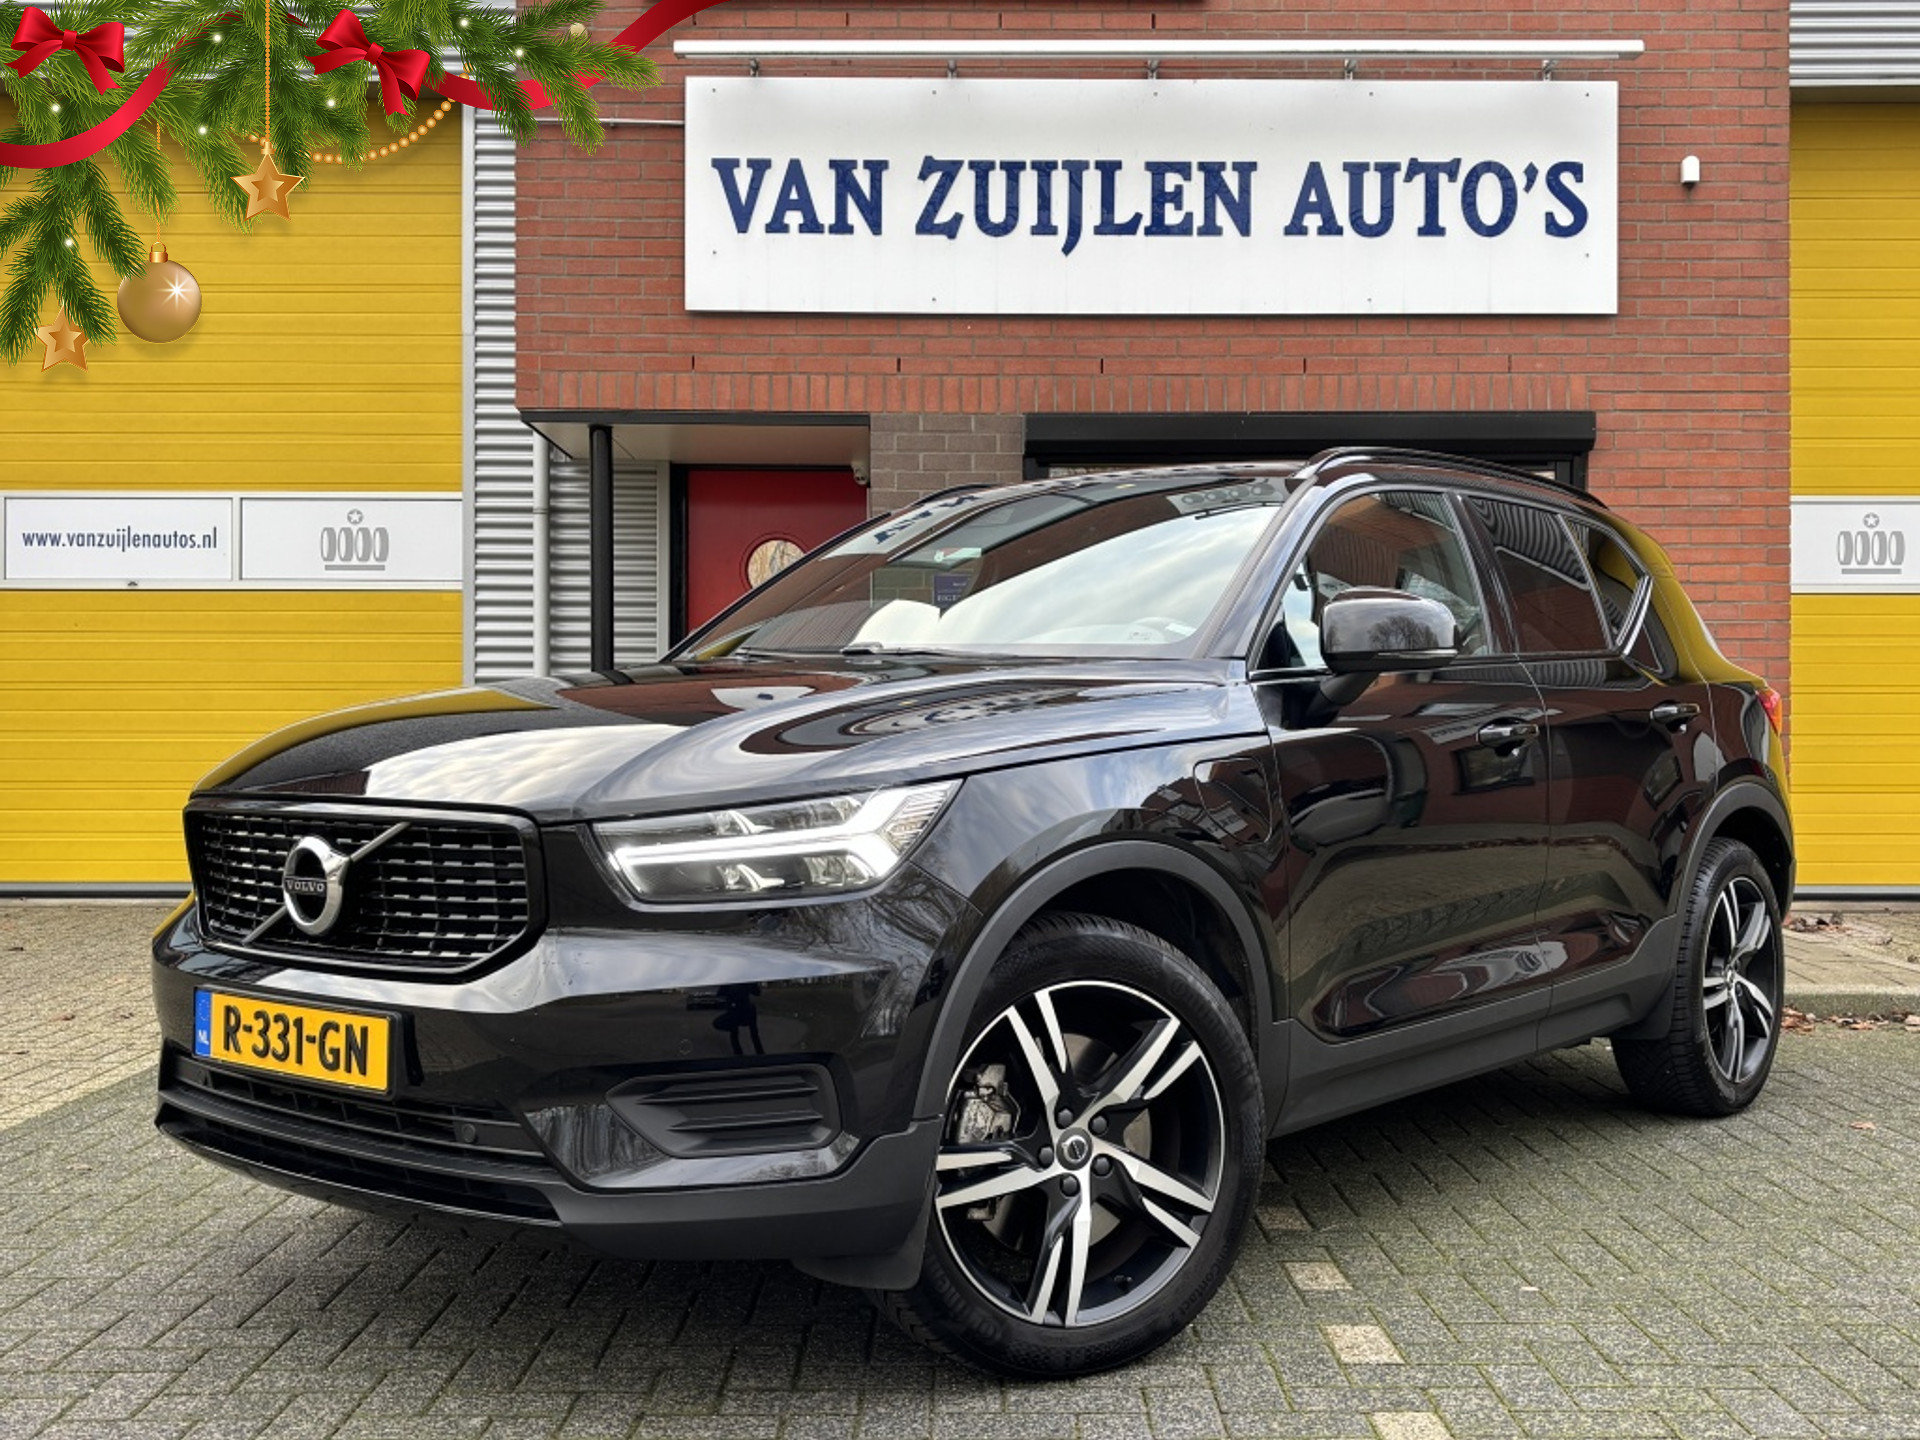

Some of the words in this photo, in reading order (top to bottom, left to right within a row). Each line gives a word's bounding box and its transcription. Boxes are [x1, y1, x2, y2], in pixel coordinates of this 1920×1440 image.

[712, 158, 889, 236] VAN
[915, 155, 1258, 257] ZUIJLEN
[1283, 157, 1588, 238] AUTO'S
[22, 526, 218, 553] www.vanzuijlenautos.nl
[286, 880, 326, 892] VOLVO
[223, 1005, 369, 1076] R-331-GN
